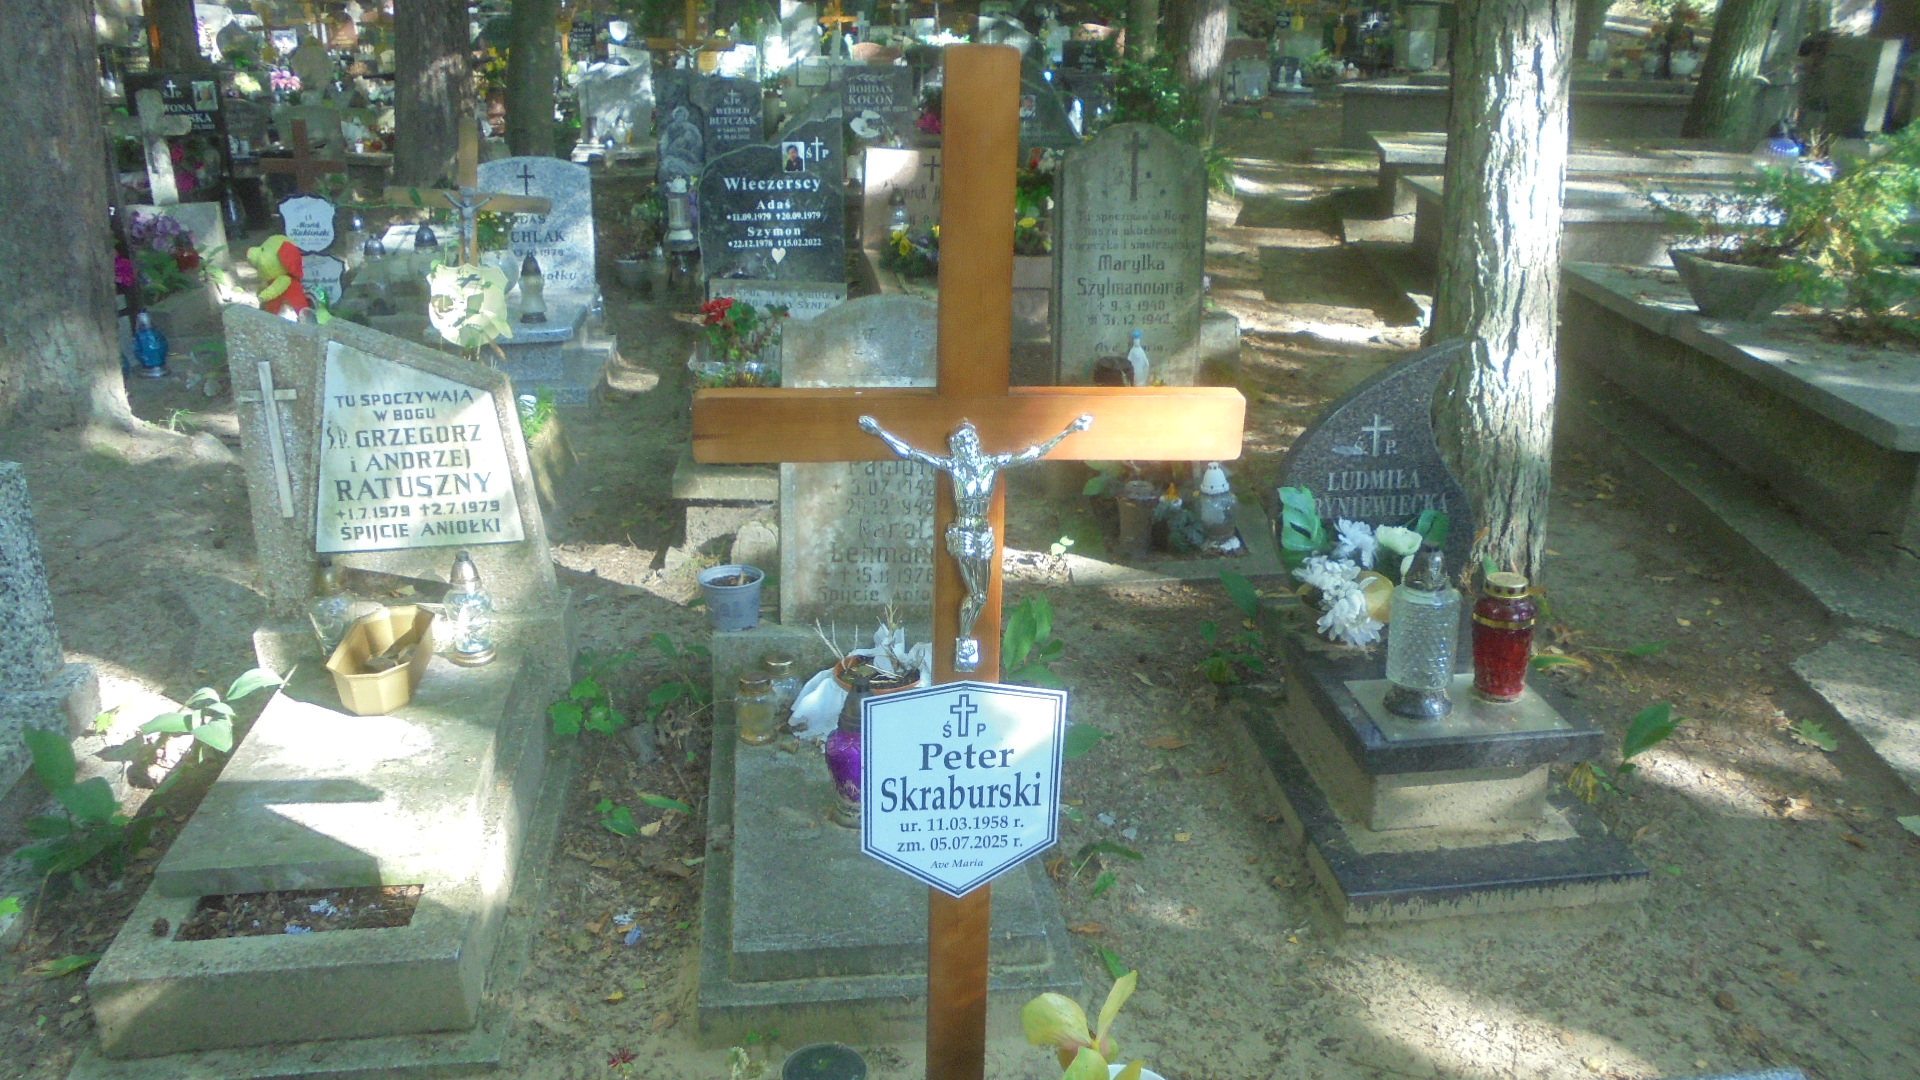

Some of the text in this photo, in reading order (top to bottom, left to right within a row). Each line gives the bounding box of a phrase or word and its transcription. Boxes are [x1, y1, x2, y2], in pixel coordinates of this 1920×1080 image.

[822, 149, 829, 158] P
[723, 177, 822, 193] Wieczerscy
[756, 199, 791, 210] Adaś
[511, 230, 566, 243] CHLAK
[747, 226, 801, 238] Szymon
[1098, 254, 1165, 274] Marylka
[335, 395, 356, 408] TU
[374, 407, 436, 422] W BOGU
[355, 424, 482, 448] GRZEGORZ
[366, 448, 472, 472] ANDRZEJ
[334, 472, 492, 502] RATUSZNY
[432, 500, 501, 516] 2.7.1979
[1316, 493, 1449, 518] RYNIEWIECKA
[340, 518, 501, 543] ŚPIJCIE ANIOŁKI
[942, 721, 987, 739] Ś P
[919, 743, 1015, 772] Peter
[881, 771, 1042, 813] Skraburski
[900, 815, 1025, 832] ur. 11.03.1958 r.
[897, 834, 1023, 853] zm. 05.07.2025 r.
[930, 858, 984, 869] Ave Maria
